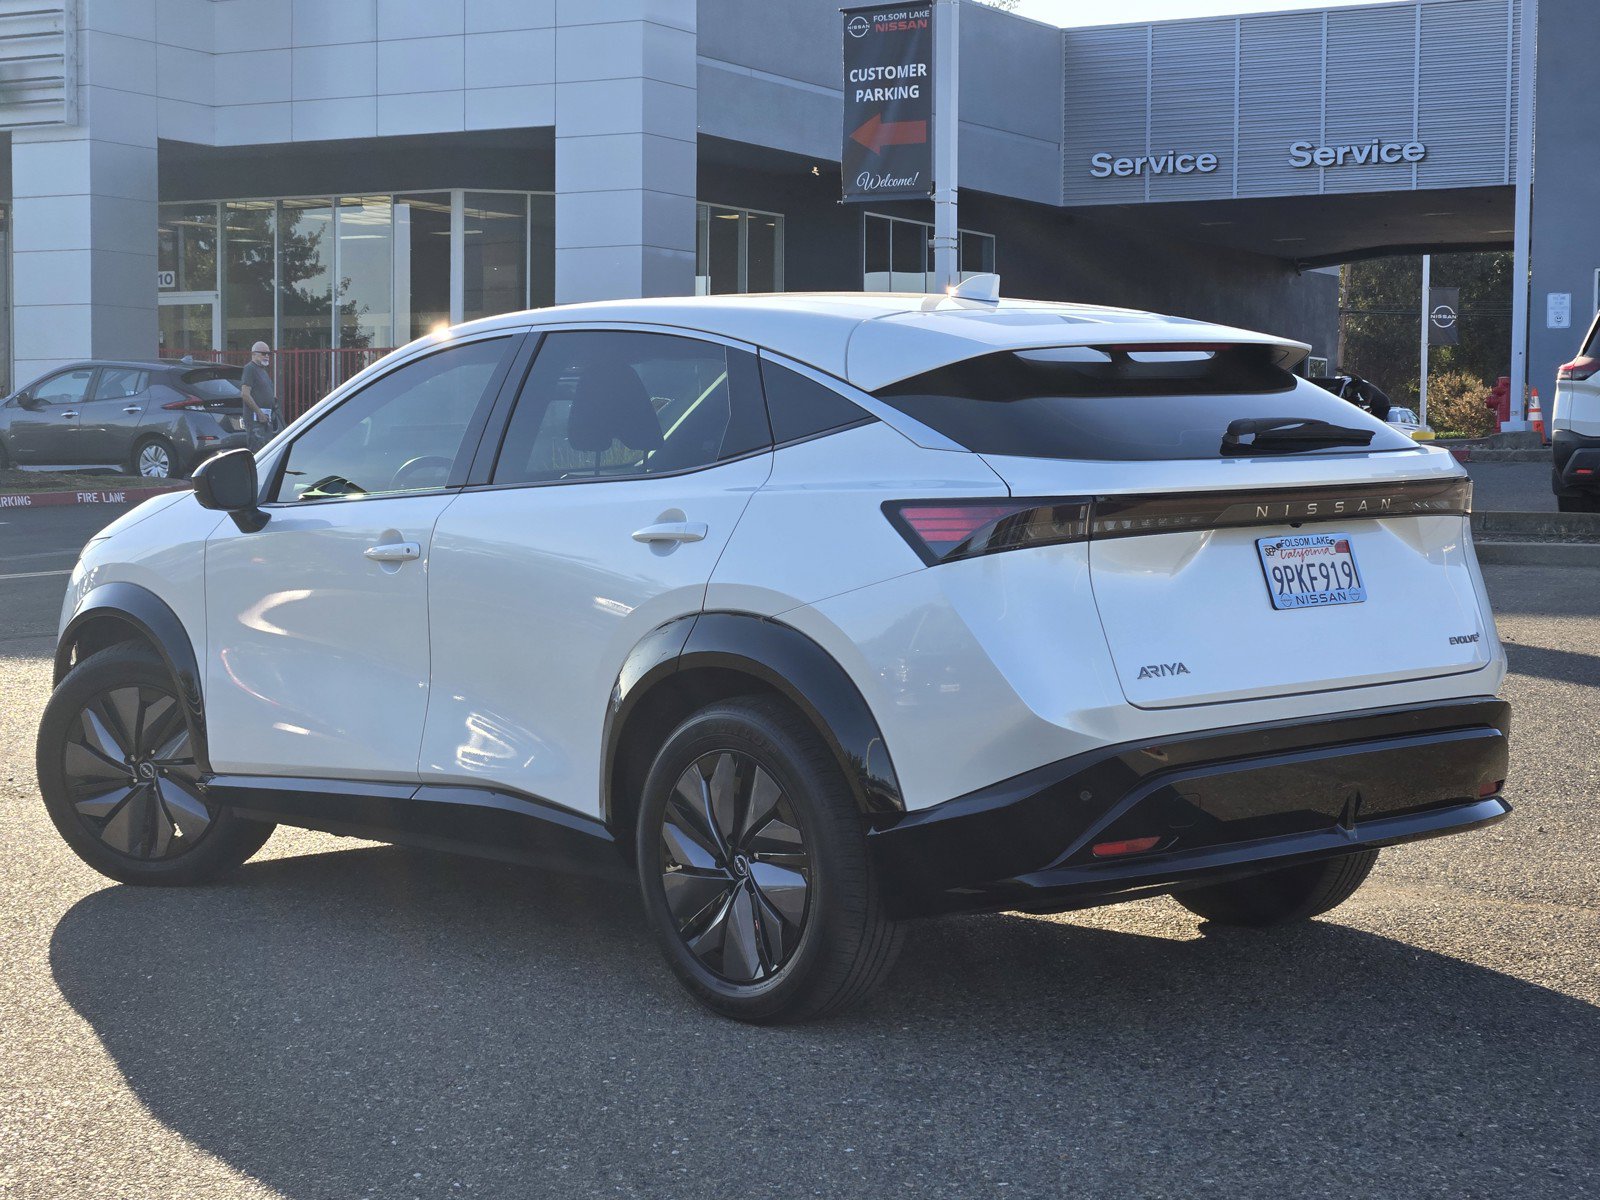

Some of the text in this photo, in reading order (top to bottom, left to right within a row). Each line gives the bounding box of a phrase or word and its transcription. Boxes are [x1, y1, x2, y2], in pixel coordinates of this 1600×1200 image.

[873, 10, 930, 22] FOLSOM LAKE
[875, 19, 928, 32] NISSAN
[850, 63, 927, 83] CUSTOMER
[855, 84, 920, 103] PARKING
[1289, 138, 1426, 168] Service
[1090, 150, 1219, 178] Service
[856, 171, 920, 191] Welcome!
[158, 273, 173, 285] 10
[0, 495, 32, 508] RKING
[77, 492, 127, 503] FIRE LANE
[1256, 498, 1391, 518] NISSAN
[1281, 536, 1330, 548] FOLSOM LAKE
[1280, 547, 1337, 563] California
[1272, 561, 1353, 595] 9PKF919
[1295, 592, 1347, 605] NISSAN
[1137, 662, 1191, 680] ARIYA
